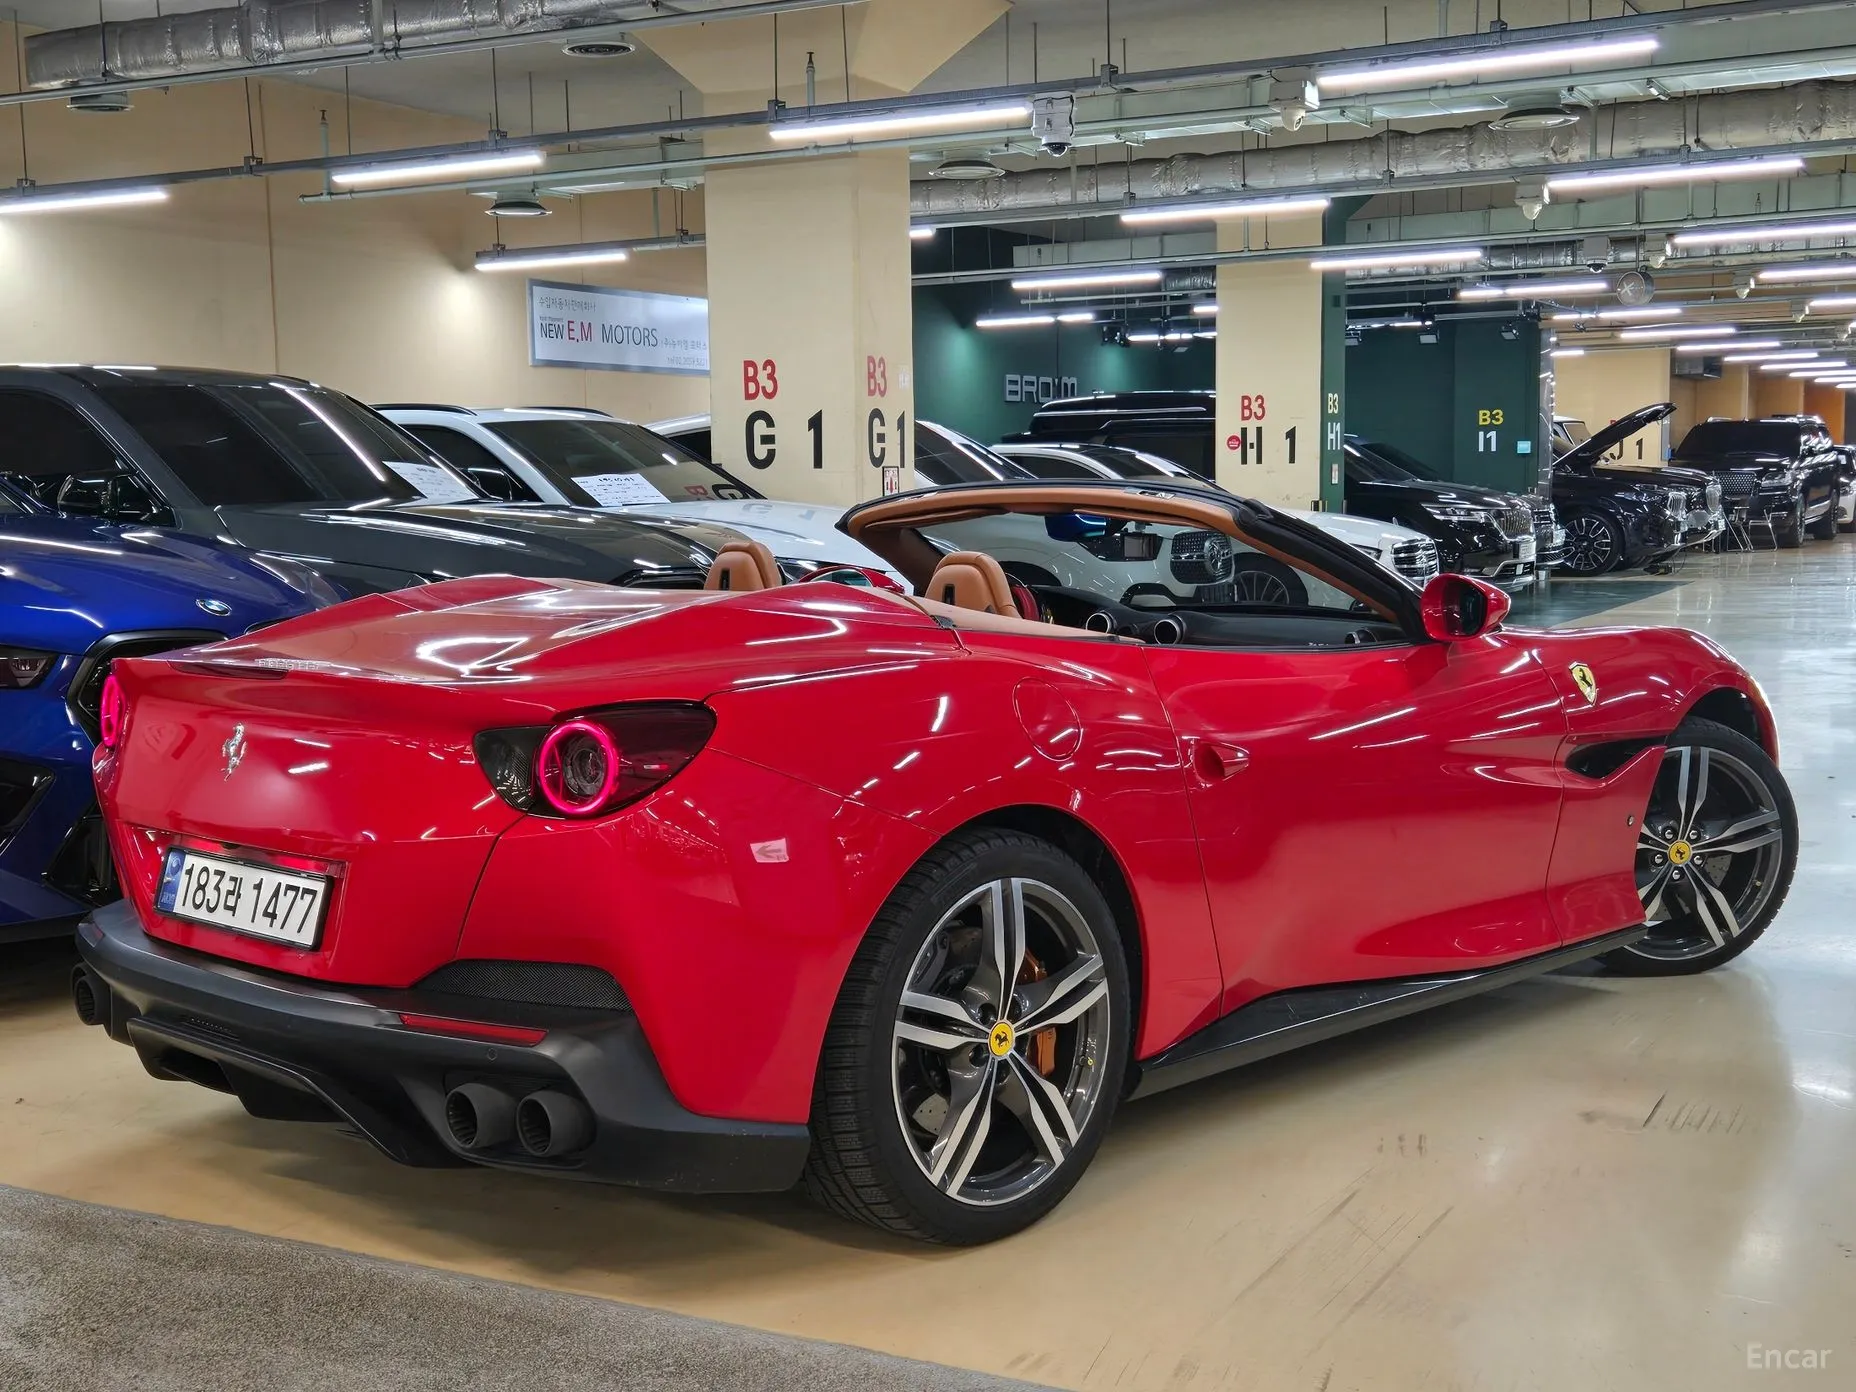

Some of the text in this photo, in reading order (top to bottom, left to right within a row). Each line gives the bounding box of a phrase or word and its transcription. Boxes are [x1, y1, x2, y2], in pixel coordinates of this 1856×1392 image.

[540, 320, 659, 348] NEW E.M MOTORS
[743, 359, 778, 400] B3
[867, 355, 888, 397] B3
[1241, 394, 1265, 421] B3
[1327, 393, 1339, 413] B3
[1478, 409, 1504, 426] B3
[745, 409, 823, 469] G 1
[868, 408, 906, 468] G 1
[1240, 425, 1297, 465] H 1
[1327, 422, 1341, 450] H1
[1609, 438, 1643, 460] J 1
[182, 863, 318, 934] 183라 1477
